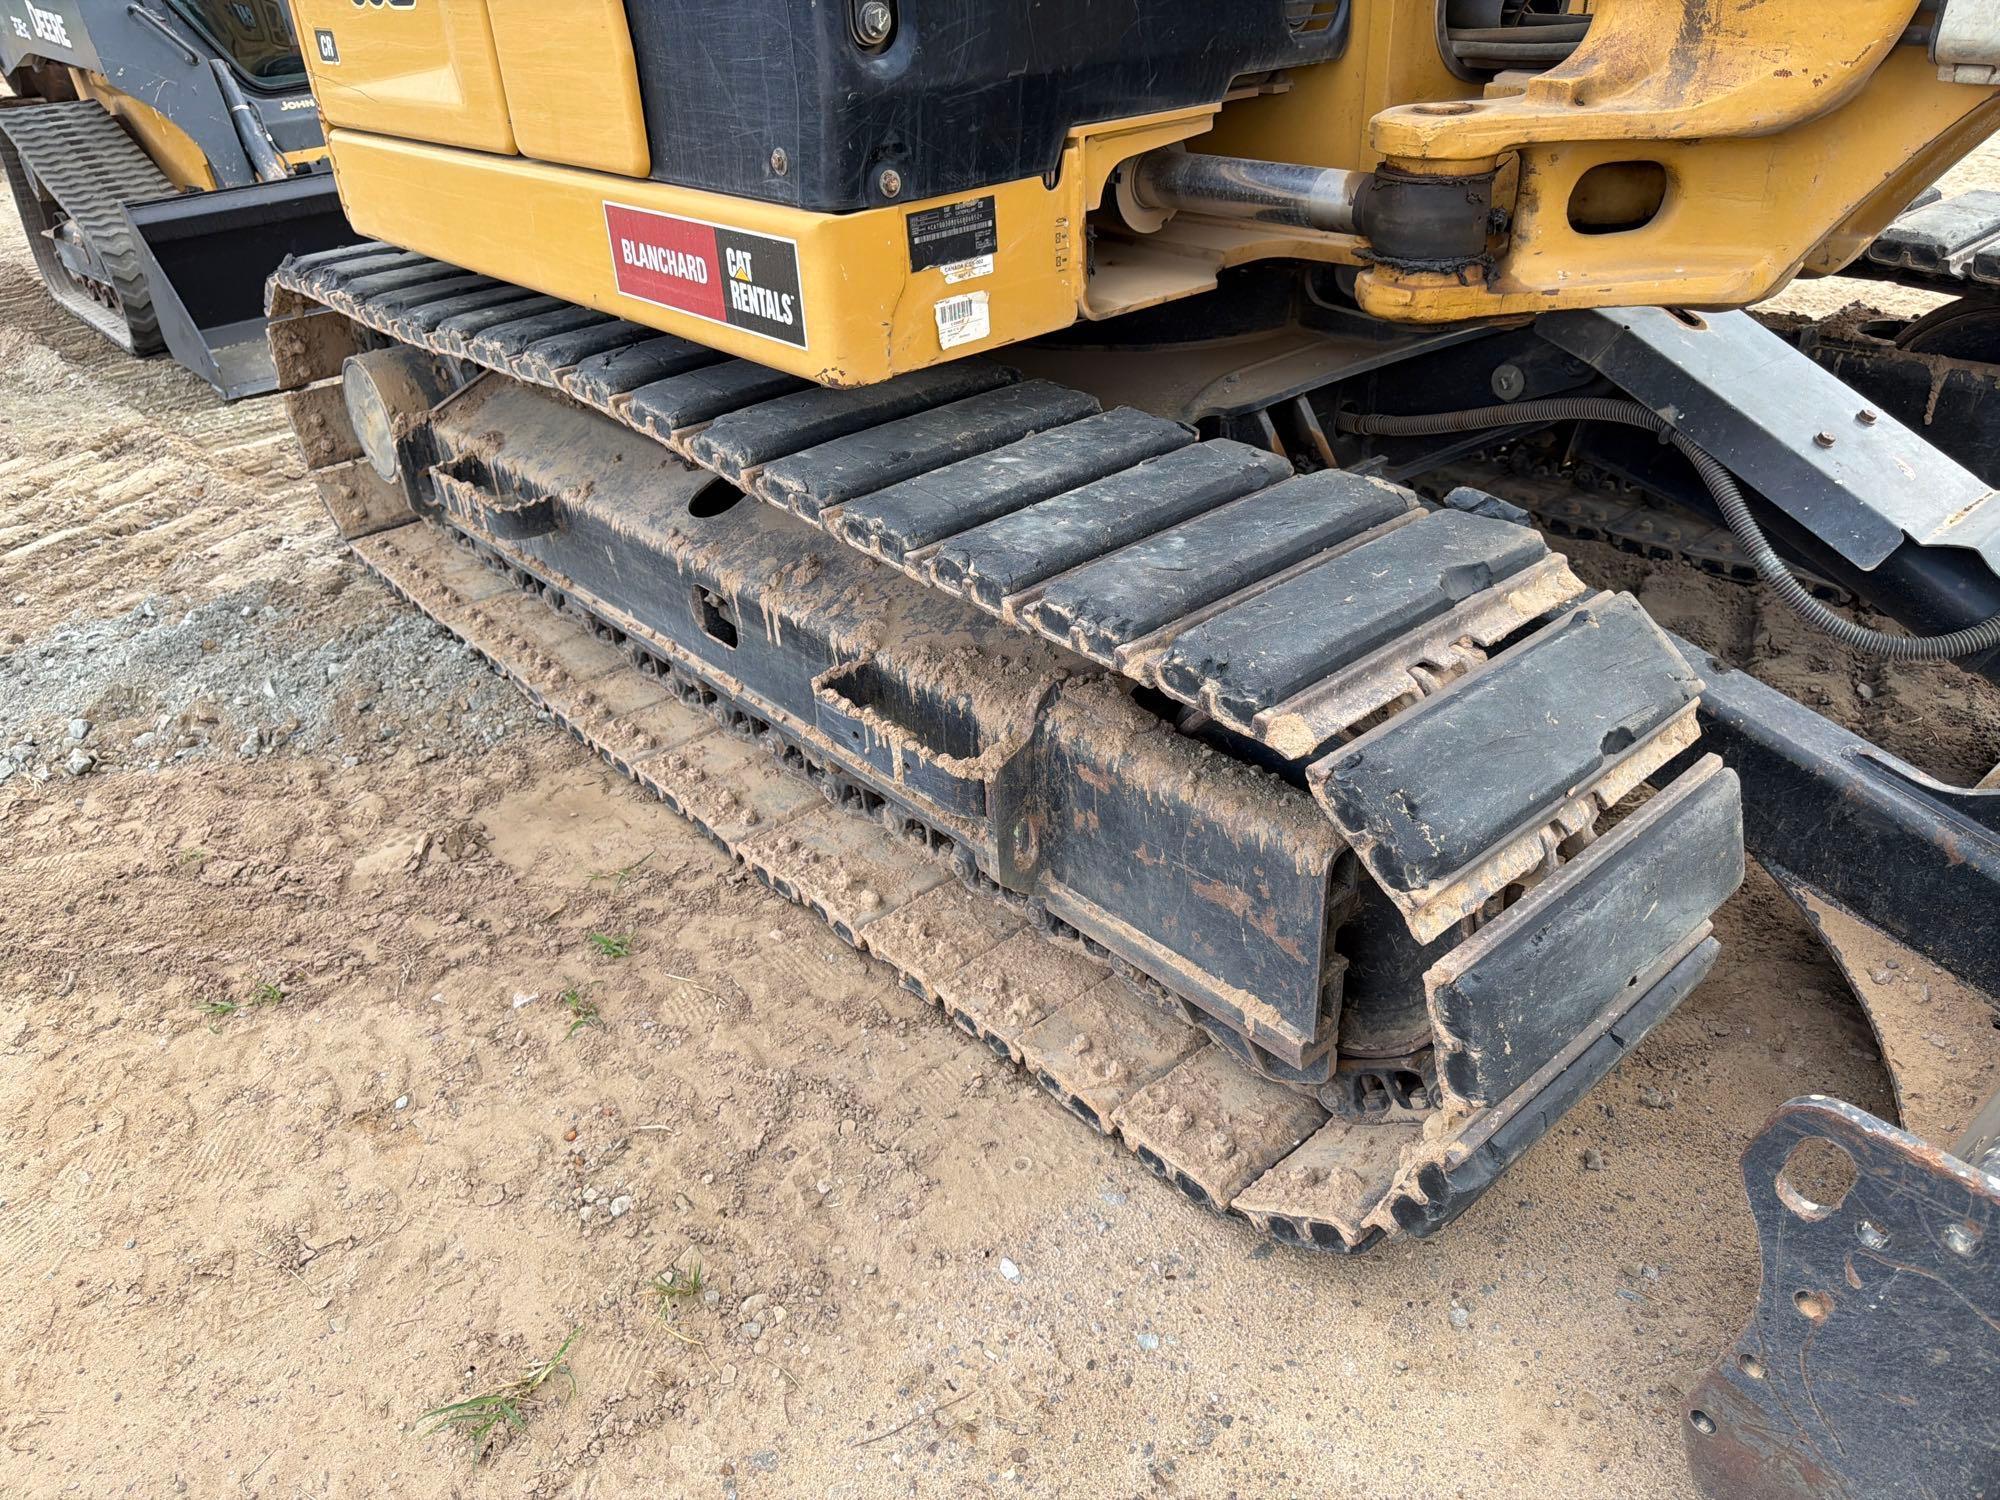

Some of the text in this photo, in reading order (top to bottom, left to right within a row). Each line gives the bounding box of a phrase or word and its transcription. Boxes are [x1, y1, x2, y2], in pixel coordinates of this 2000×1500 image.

[24, 0, 72, 48] DEERE
[320, 34, 334, 57] CR
[281, 99, 315, 111] JOHN
[621, 238, 708, 284] BLANCHARD
[726, 247, 752, 282] CAT
[730, 280, 793, 325] RENTALS
